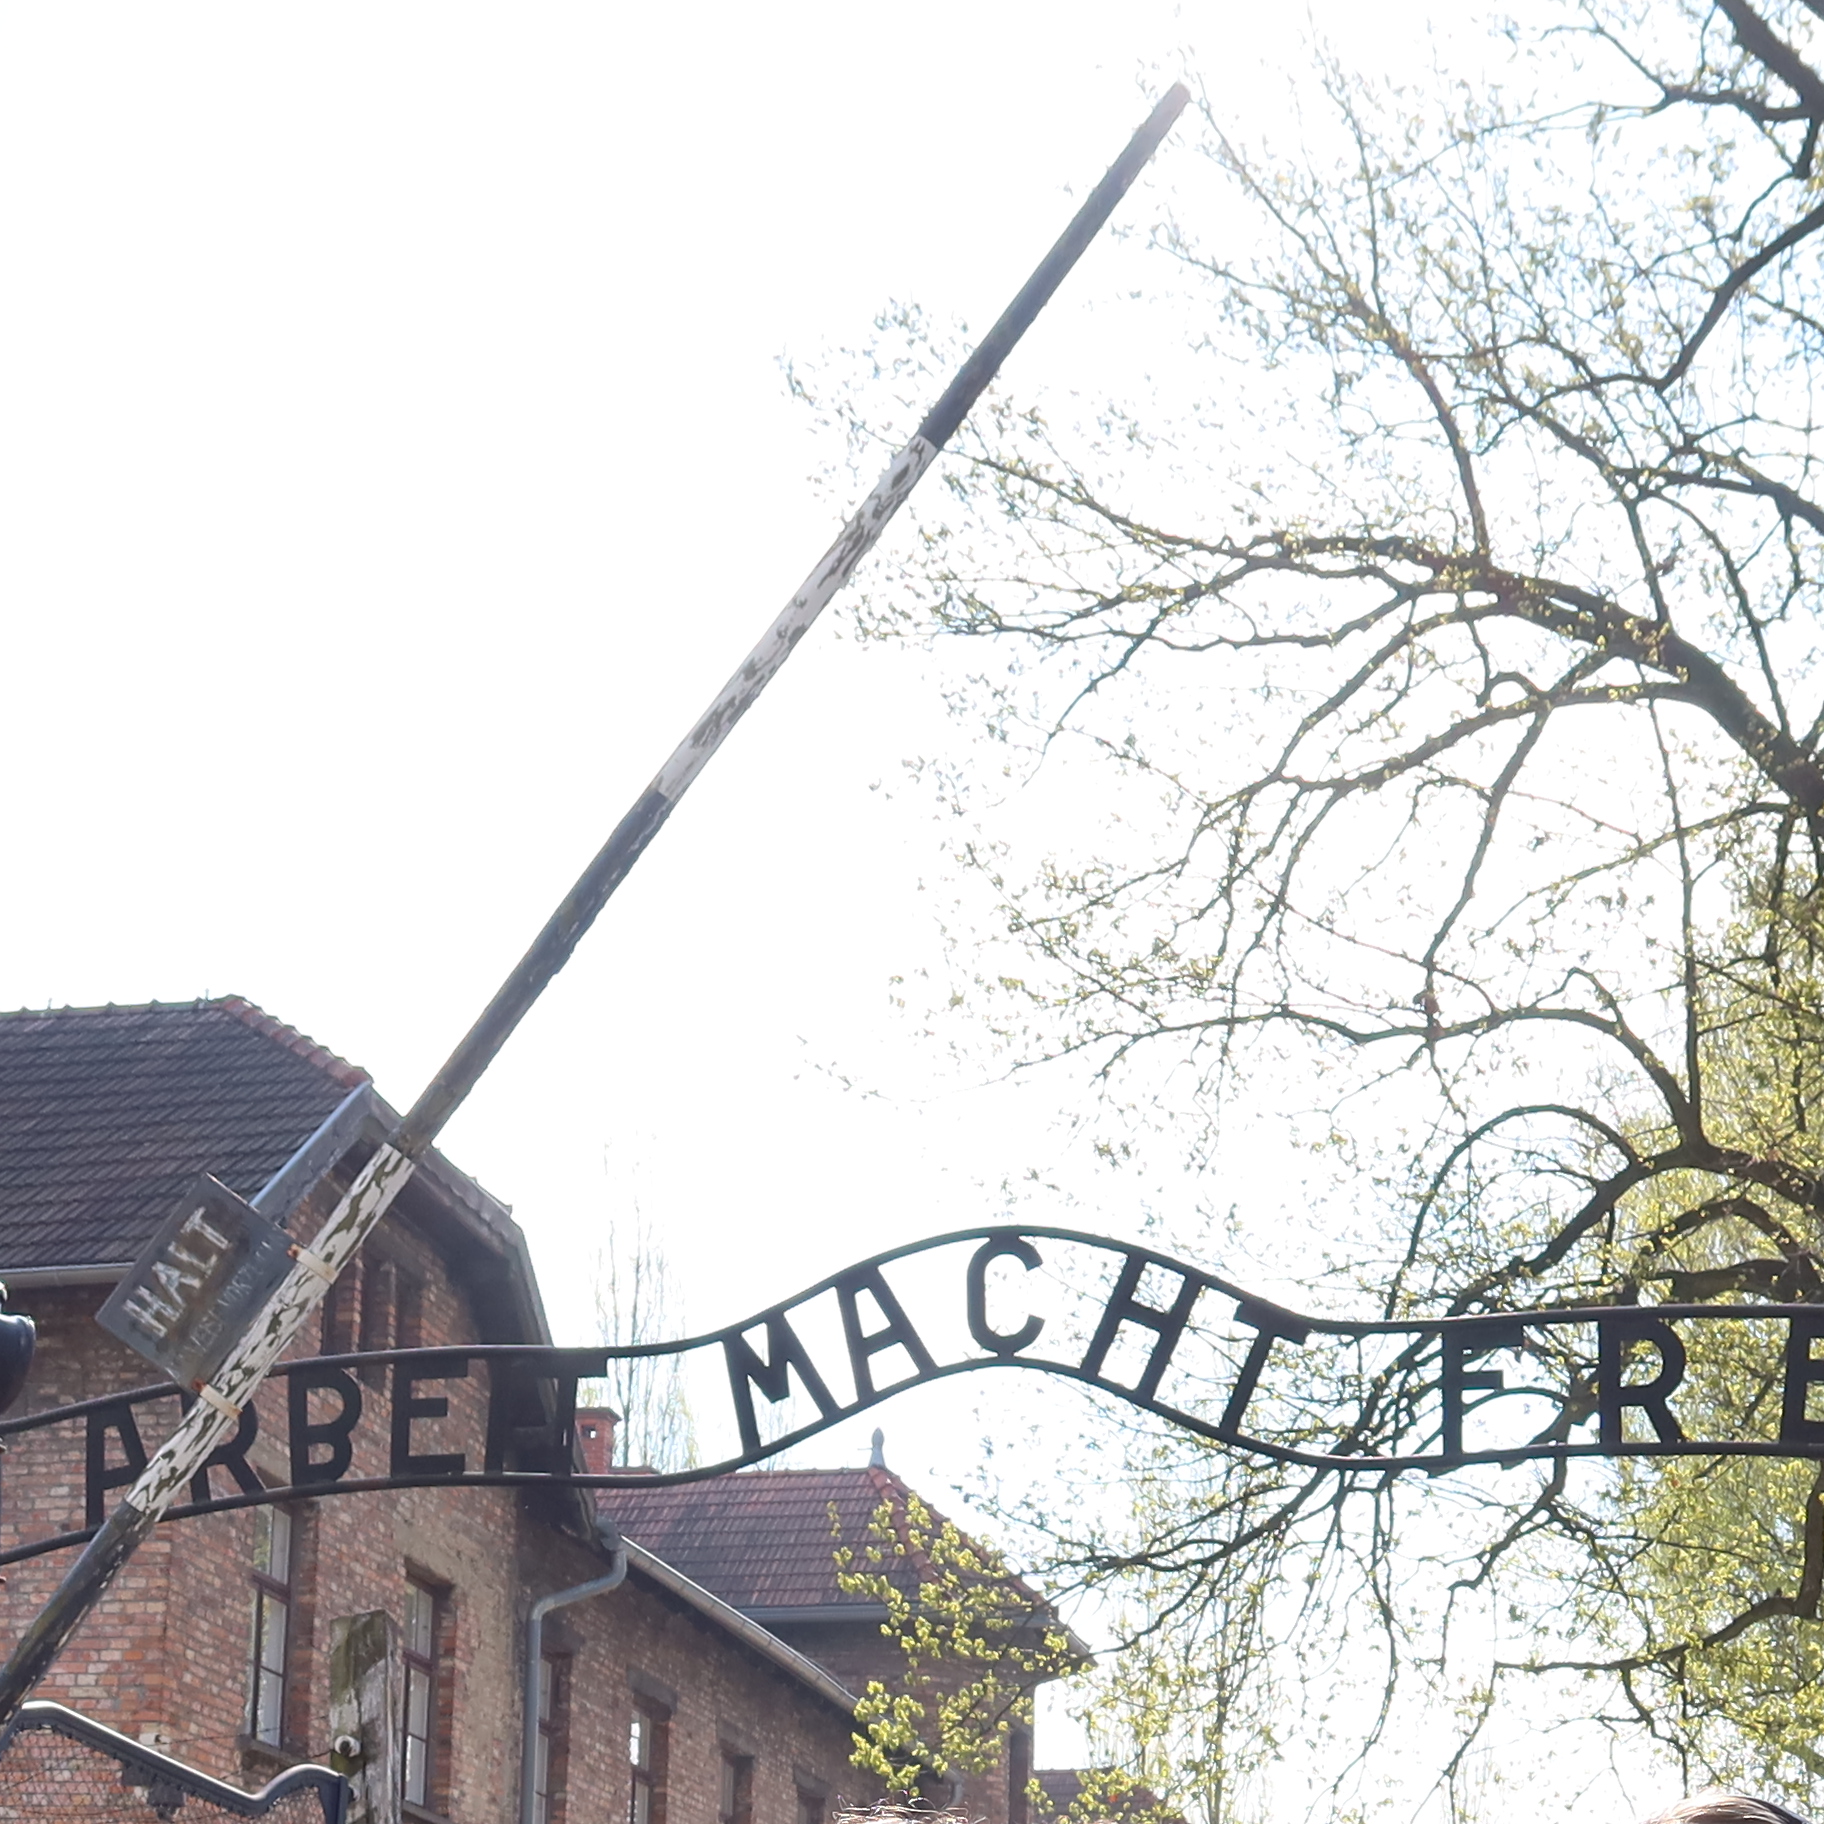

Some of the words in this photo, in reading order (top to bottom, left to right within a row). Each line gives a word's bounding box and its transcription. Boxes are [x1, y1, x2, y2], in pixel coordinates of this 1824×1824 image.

[124, 1206, 230, 1338] HALT
[85, 1357, 607, 1528] ARBEIT
[722, 1232, 1309, 1456] MACHT
